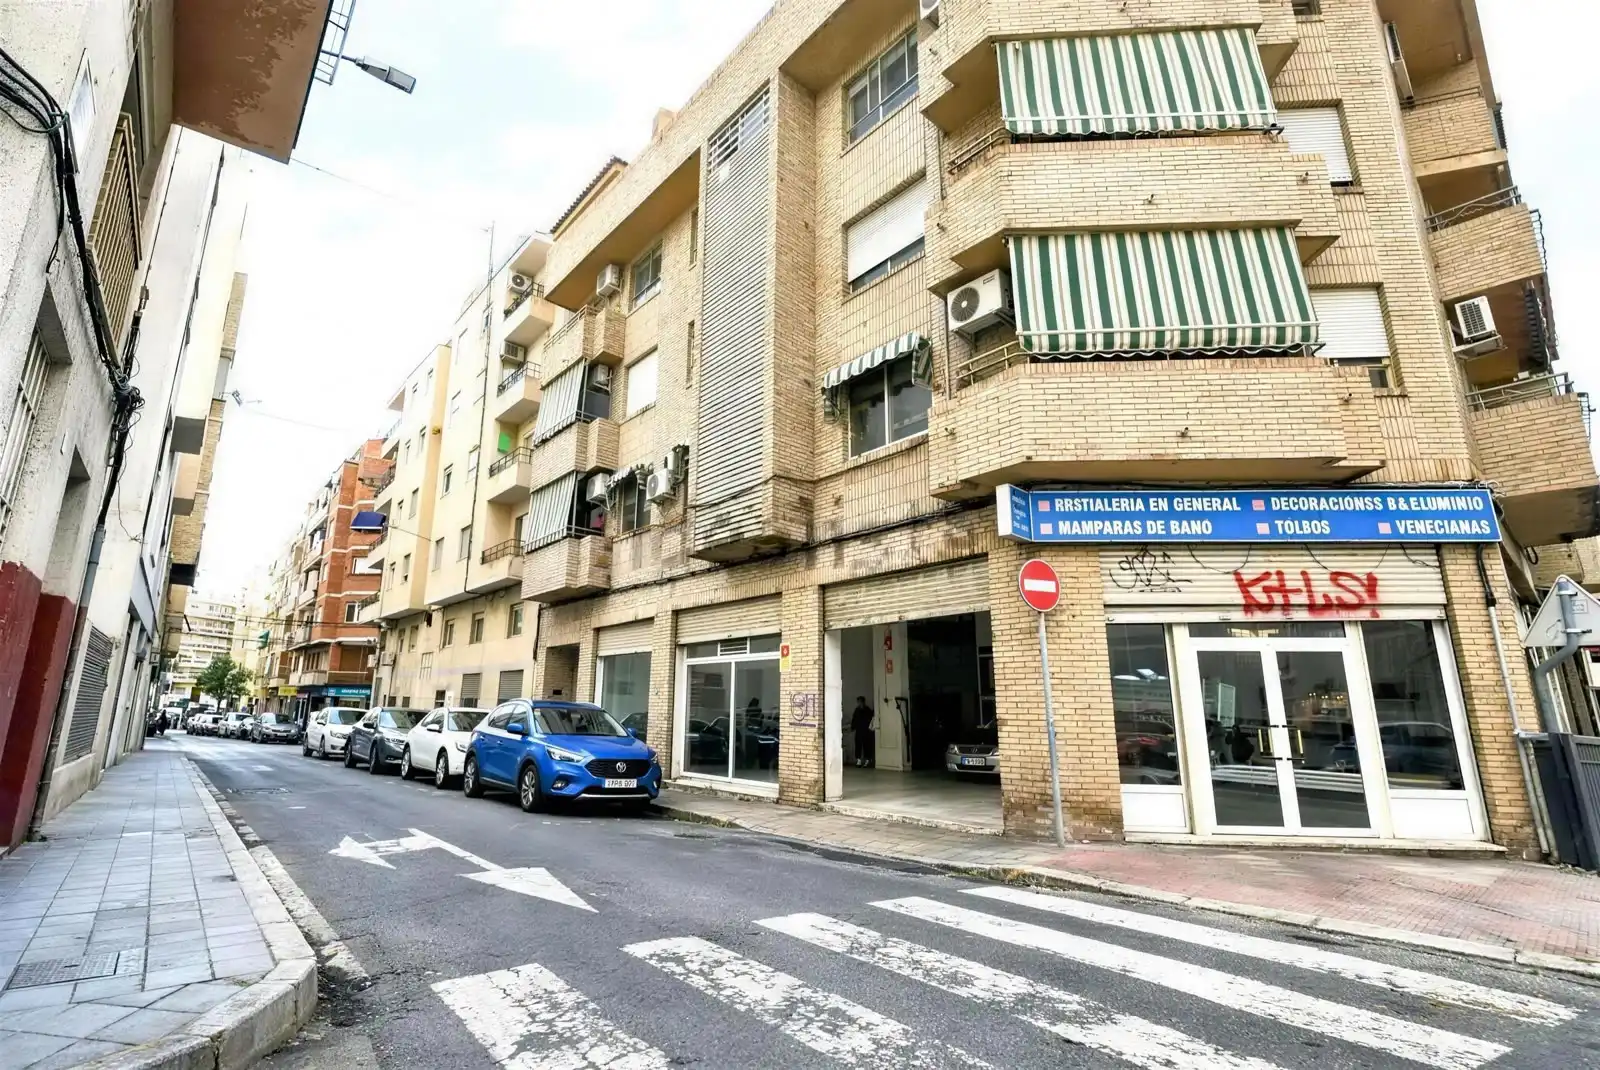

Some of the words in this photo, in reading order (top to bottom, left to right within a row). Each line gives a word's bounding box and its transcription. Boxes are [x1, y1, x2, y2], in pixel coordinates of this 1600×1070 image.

[1148, 497, 1169, 512] EN
[1172, 496, 1242, 512] GENERAL
[1058, 520, 1143, 535] MAMPARAS
[1146, 520, 1167, 535] DE
[1395, 519, 1491, 535] VENECIANAS
